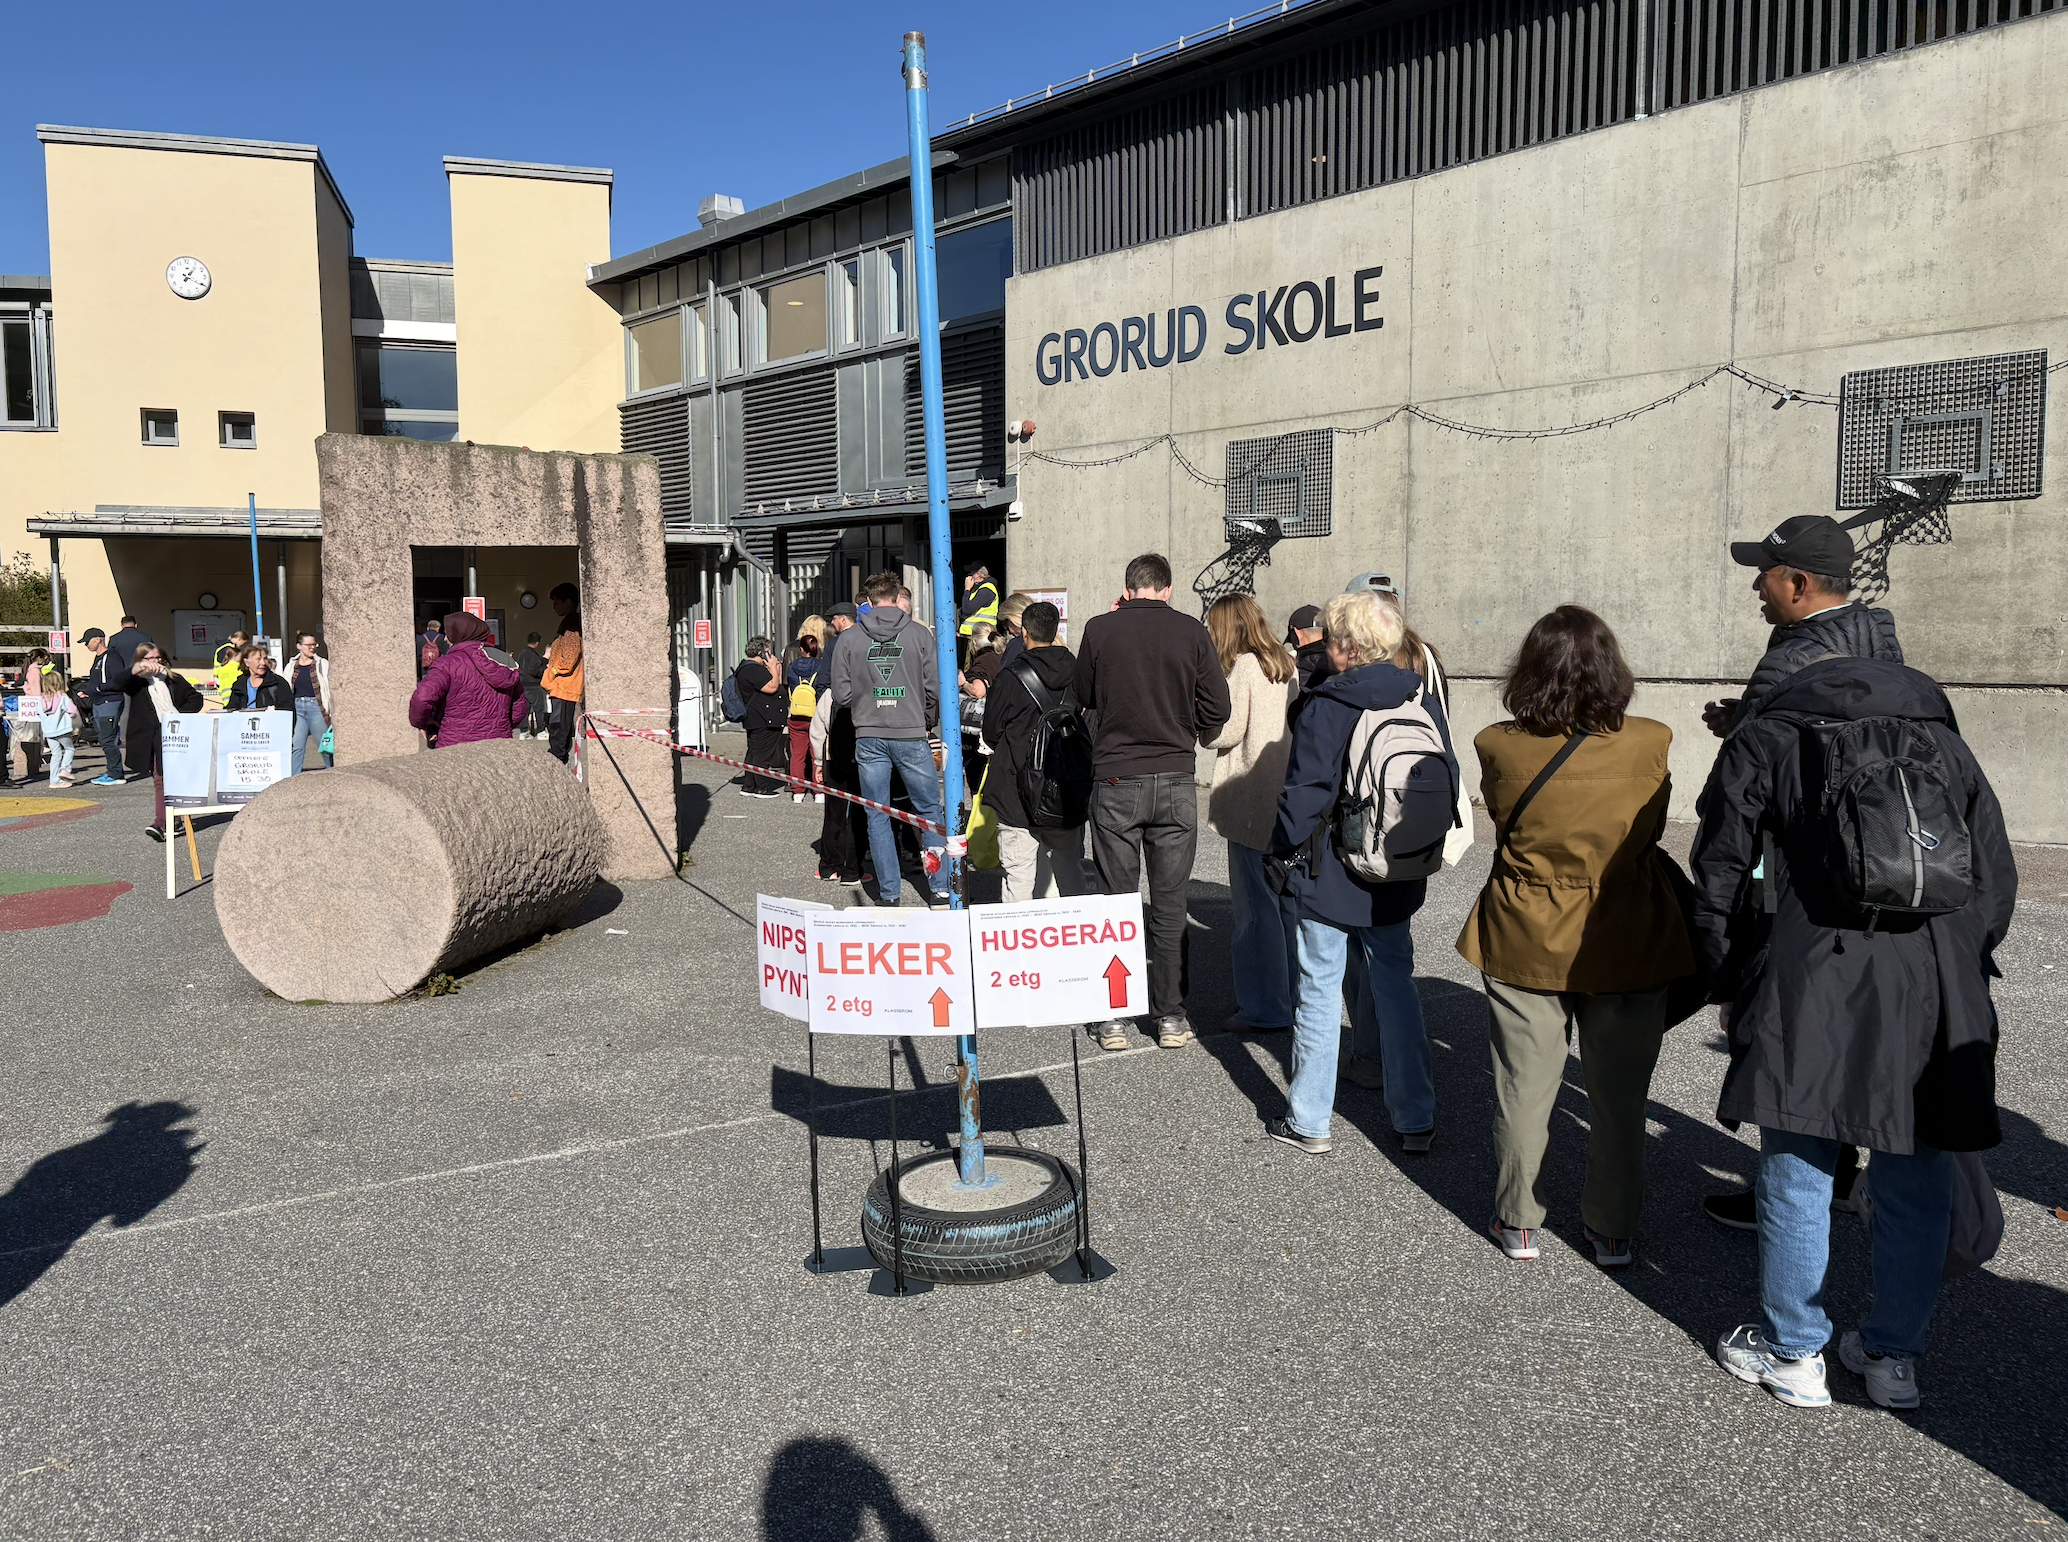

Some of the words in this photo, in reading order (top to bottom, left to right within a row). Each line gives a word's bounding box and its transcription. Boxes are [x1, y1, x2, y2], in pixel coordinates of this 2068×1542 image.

[1036, 304, 1207, 386] GRORUD
[1224, 265, 1384, 355] SKOLE
[241, 732, 270, 740] SAMMEN
[763, 921, 807, 955] NIPS
[981, 918, 1138, 952] HUSGERÅD
[817, 942, 954, 976] LEKER
[990, 970, 1002, 988] 2
[1008, 970, 1041, 990] etg
[826, 995, 836, 1012] 2
[842, 996, 873, 1017] etg
